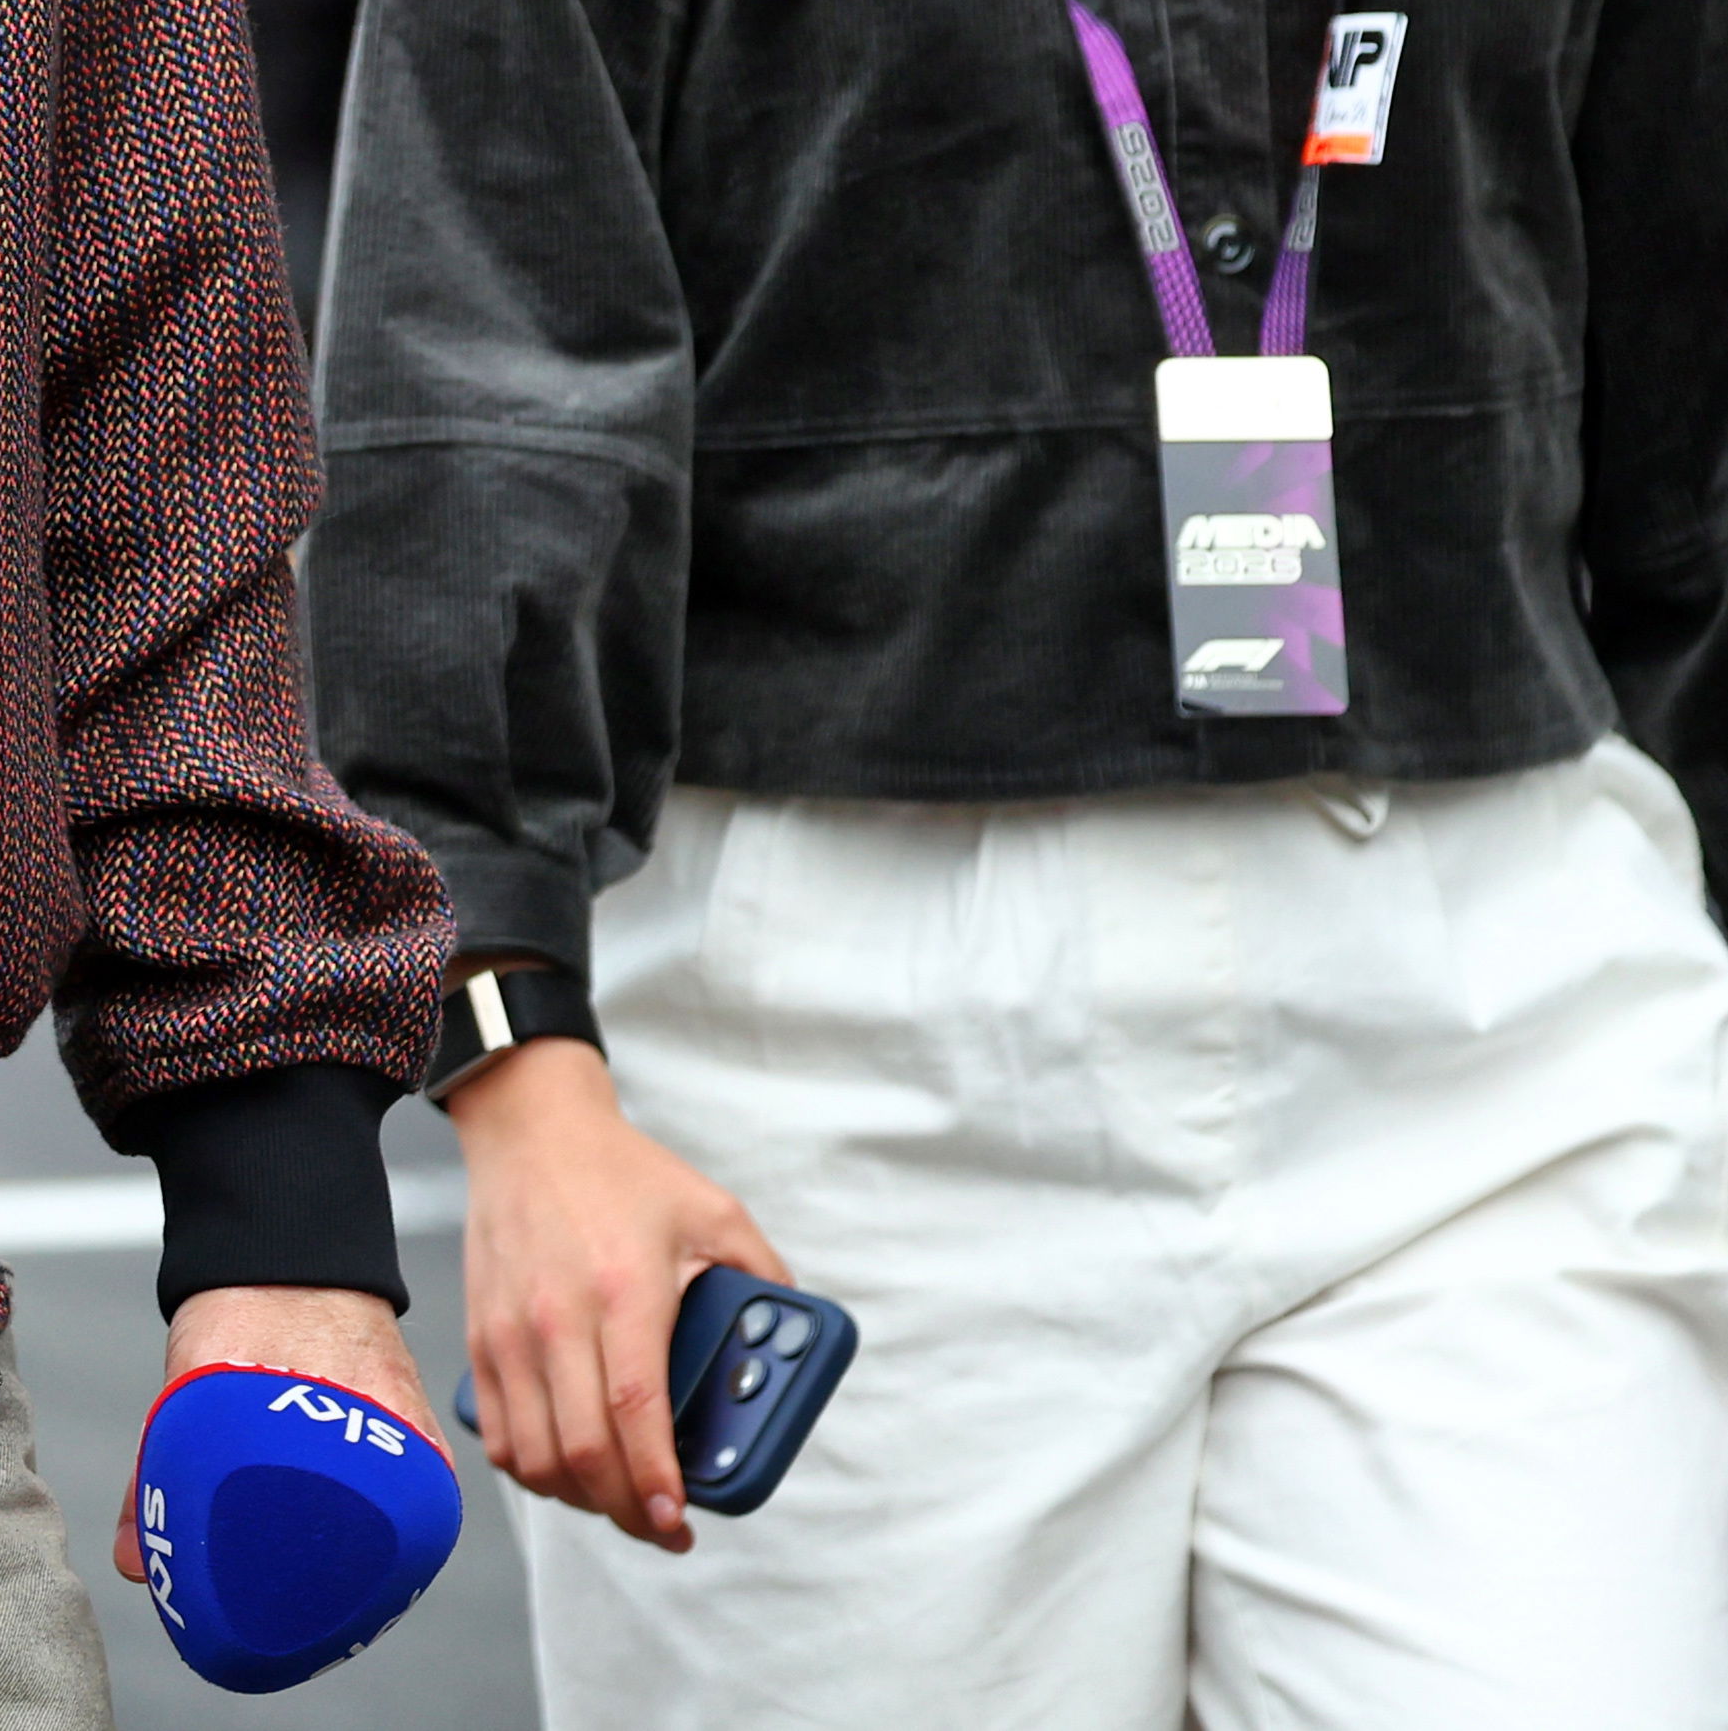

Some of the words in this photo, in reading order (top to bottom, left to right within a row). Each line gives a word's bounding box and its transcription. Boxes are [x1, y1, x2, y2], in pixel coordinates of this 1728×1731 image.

[1116, 123, 1177, 251] 2026
[1176, 513, 1326, 551] MEDIA
[268, 1384, 406, 1456] sky
